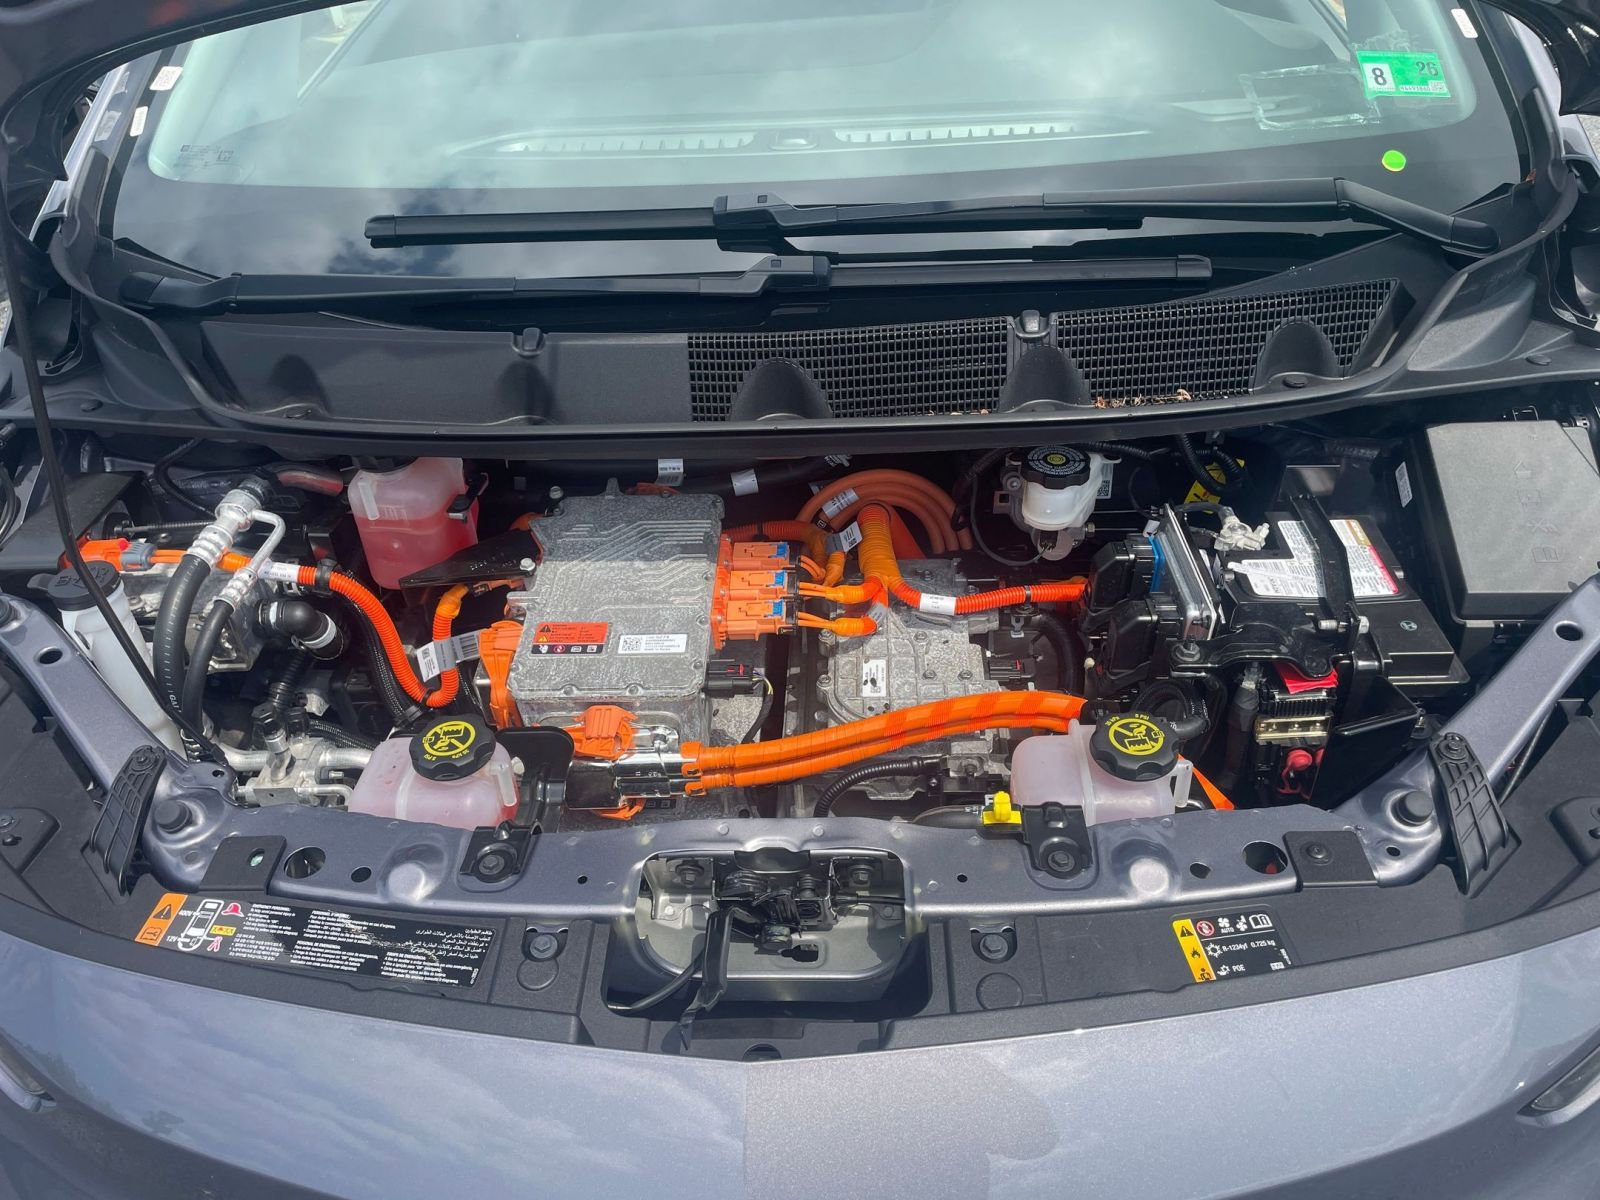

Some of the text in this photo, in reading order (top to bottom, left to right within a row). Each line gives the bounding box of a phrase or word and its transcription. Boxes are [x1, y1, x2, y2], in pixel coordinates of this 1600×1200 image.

[1416, 61, 1439, 76] 26
[1372, 67, 1387, 85] 8
[1222, 943, 1248, 952] R-1234yf
[1232, 964, 1245, 972] POE
